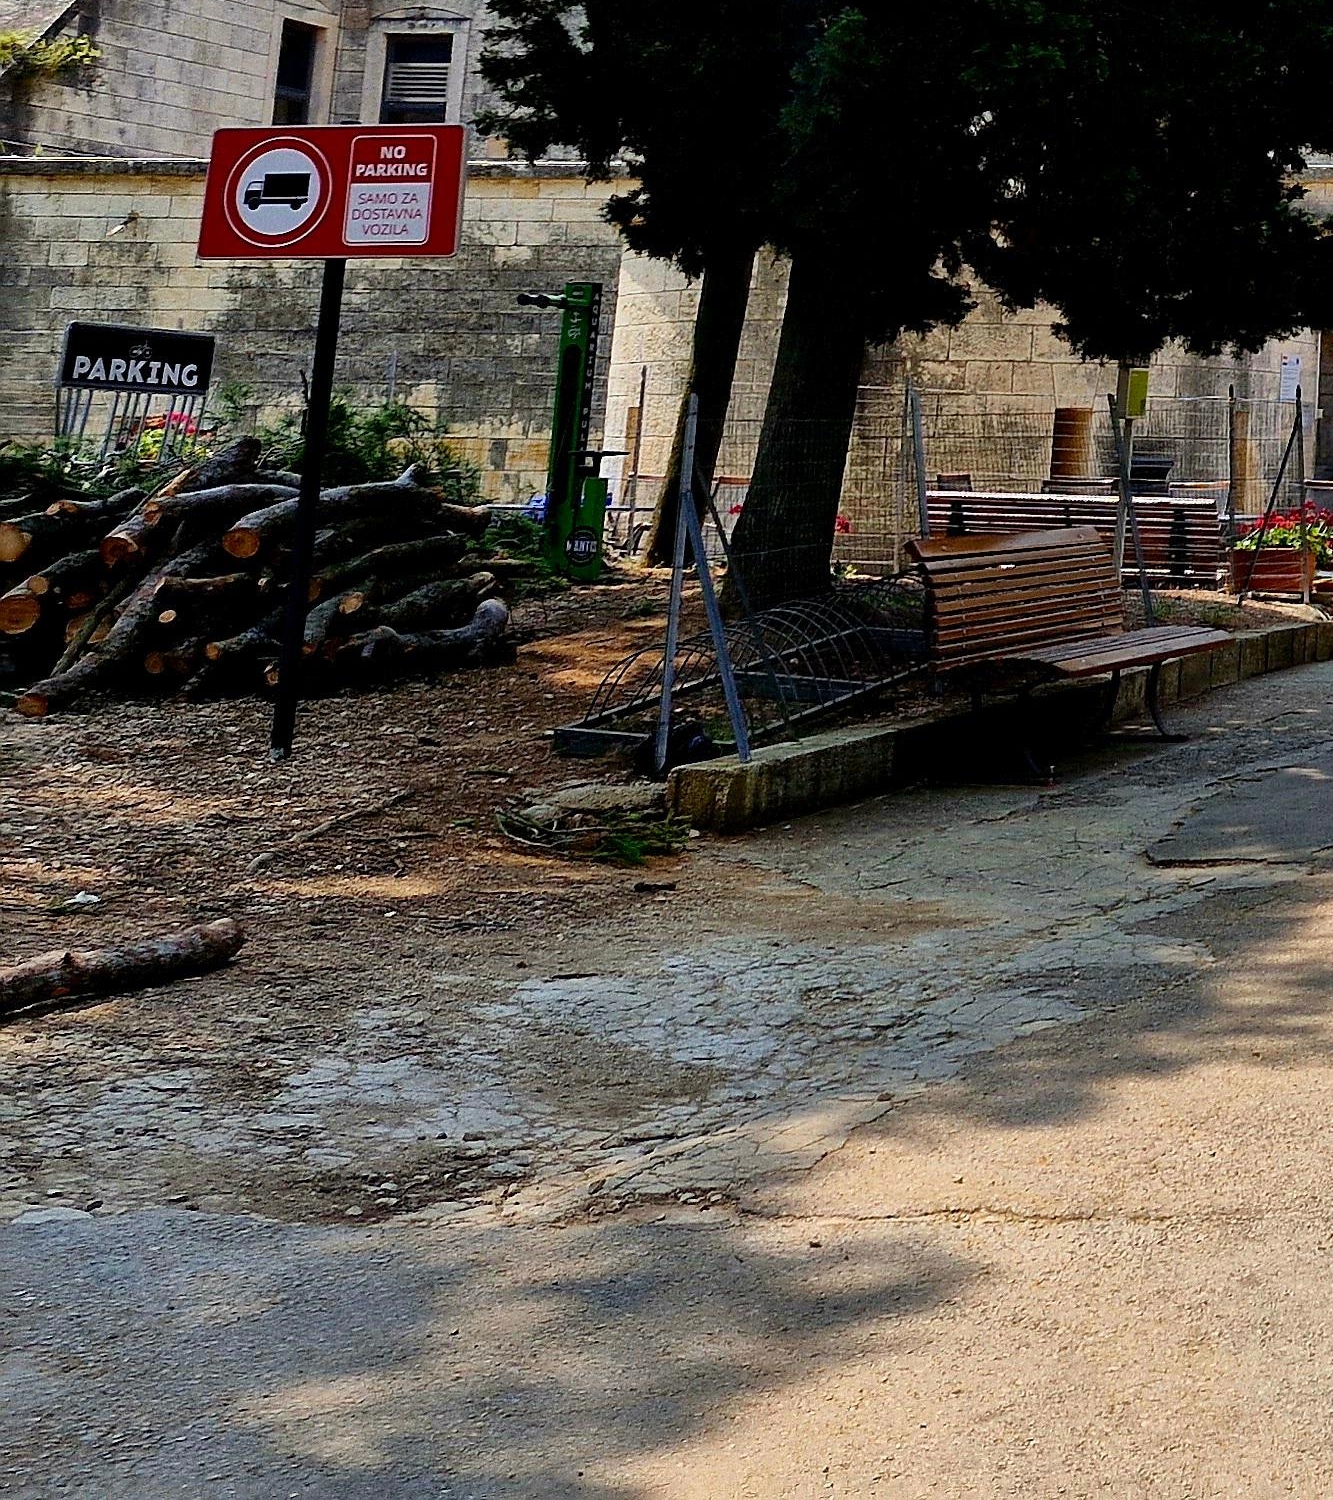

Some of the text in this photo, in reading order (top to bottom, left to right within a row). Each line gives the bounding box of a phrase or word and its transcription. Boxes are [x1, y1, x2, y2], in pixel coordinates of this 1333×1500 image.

[380, 145, 407, 159] NO
[355, 163, 428, 177] PARKING
[358, 192, 418, 205] SAMO ZA
[352, 208, 422, 220] DOSTAVNA
[362, 223, 409, 236] VOZILA
[72, 355, 198, 387] PARKING
